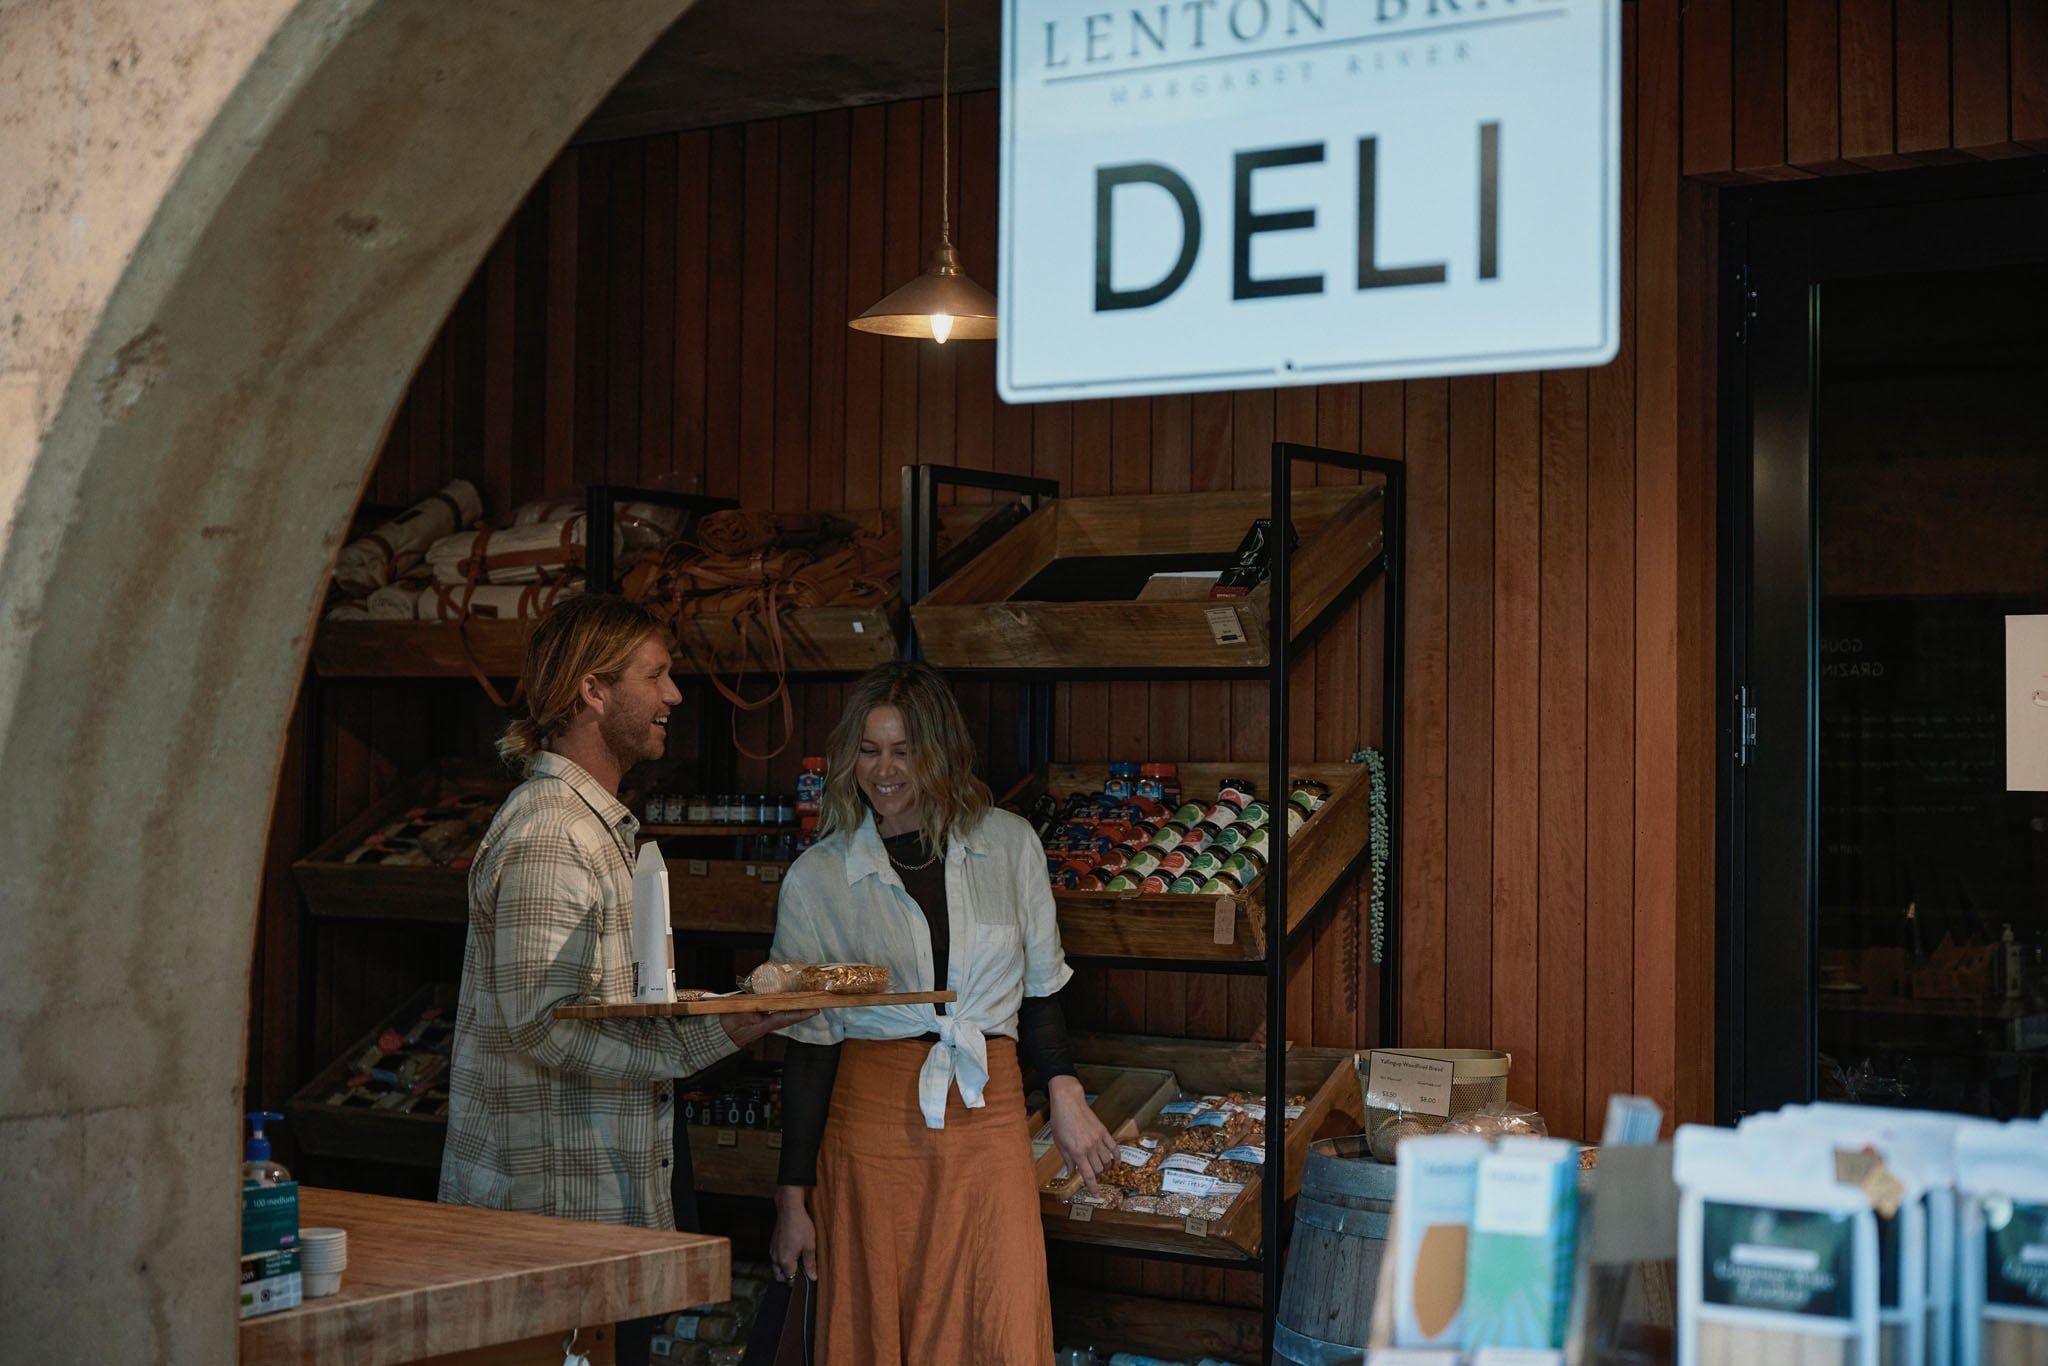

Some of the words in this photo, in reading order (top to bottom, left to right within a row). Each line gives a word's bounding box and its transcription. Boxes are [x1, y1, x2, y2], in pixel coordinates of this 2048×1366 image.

[1042, 0, 1328, 69] LENTON
[1110, 60, 1316, 104] MARGARET
[1345, 39, 1473, 75] RIVER
[1093, 119, 1502, 313] DELI
